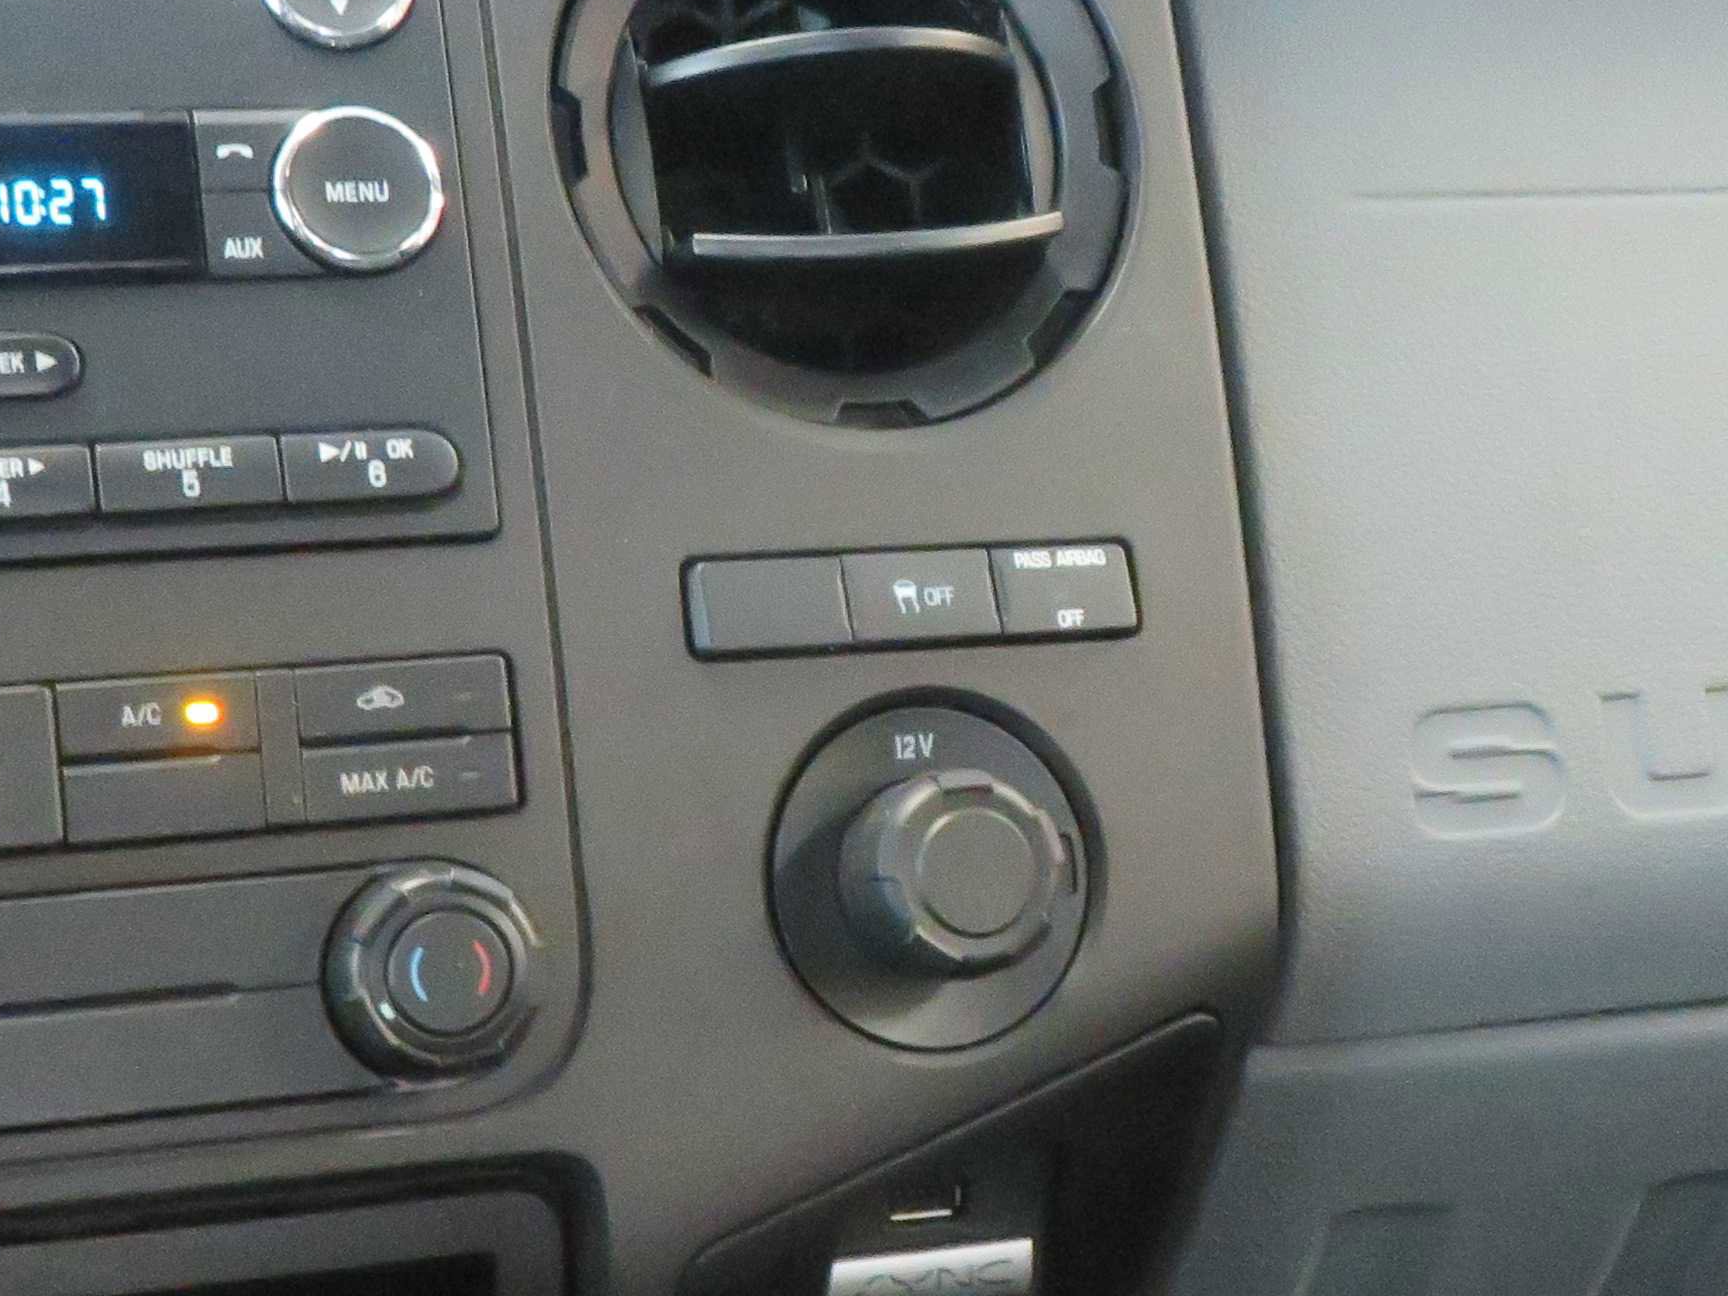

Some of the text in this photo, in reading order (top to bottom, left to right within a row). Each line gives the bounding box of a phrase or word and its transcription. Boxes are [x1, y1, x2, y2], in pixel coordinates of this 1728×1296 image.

[325, 181, 389, 204] MENU
[224, 237, 263, 260] AUX
[144, 446, 234, 472] SHUFFLE
[386, 438, 414, 459] OK
[182, 470, 201, 498] 5
[368, 459, 387, 488] 6
[1013, 548, 1107, 569] PASS AIRBAG
[923, 586, 955, 607] OFF
[1057, 608, 1085, 629] OFF
[121, 703, 161, 727] A/C
[894, 733, 934, 760] 12V
[341, 767, 435, 794] MAX A/C
